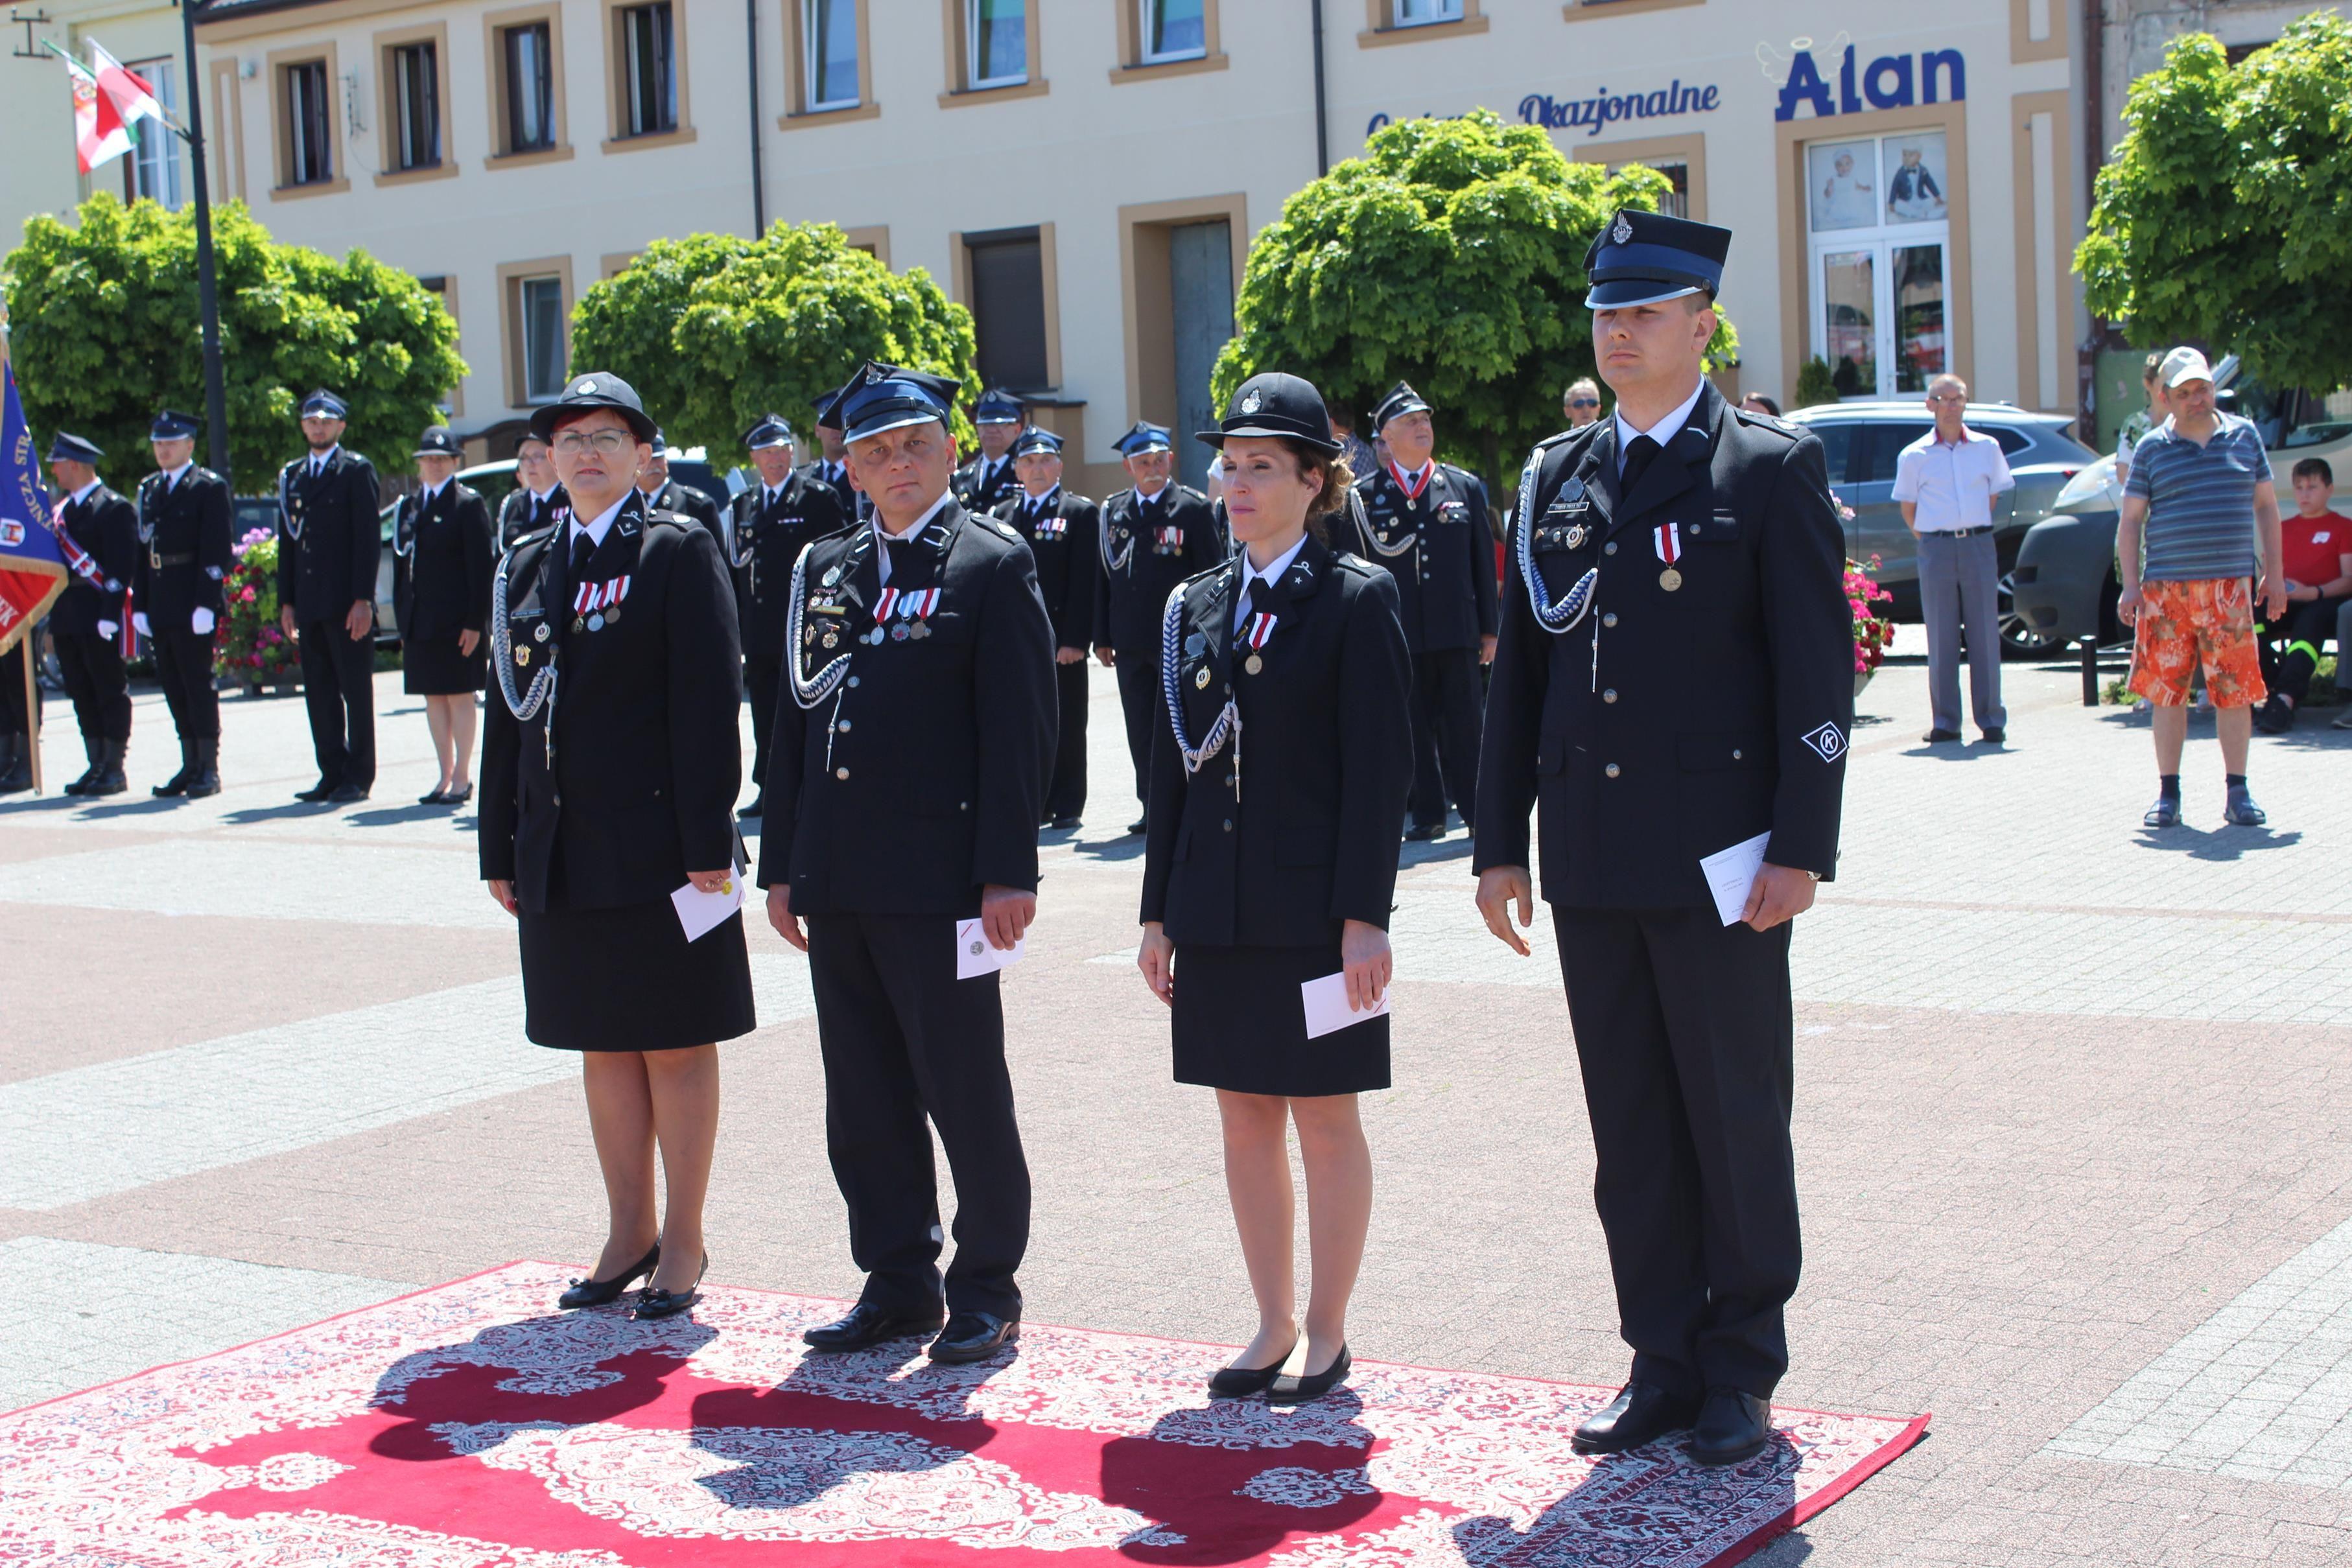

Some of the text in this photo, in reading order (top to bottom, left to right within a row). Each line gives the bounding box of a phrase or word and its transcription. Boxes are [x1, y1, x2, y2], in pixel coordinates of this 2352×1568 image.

[1518, 79, 1721, 136] Okazjonalne
[1774, 43, 1964, 122] Alan
[1824, 734, 1834, 749] K
